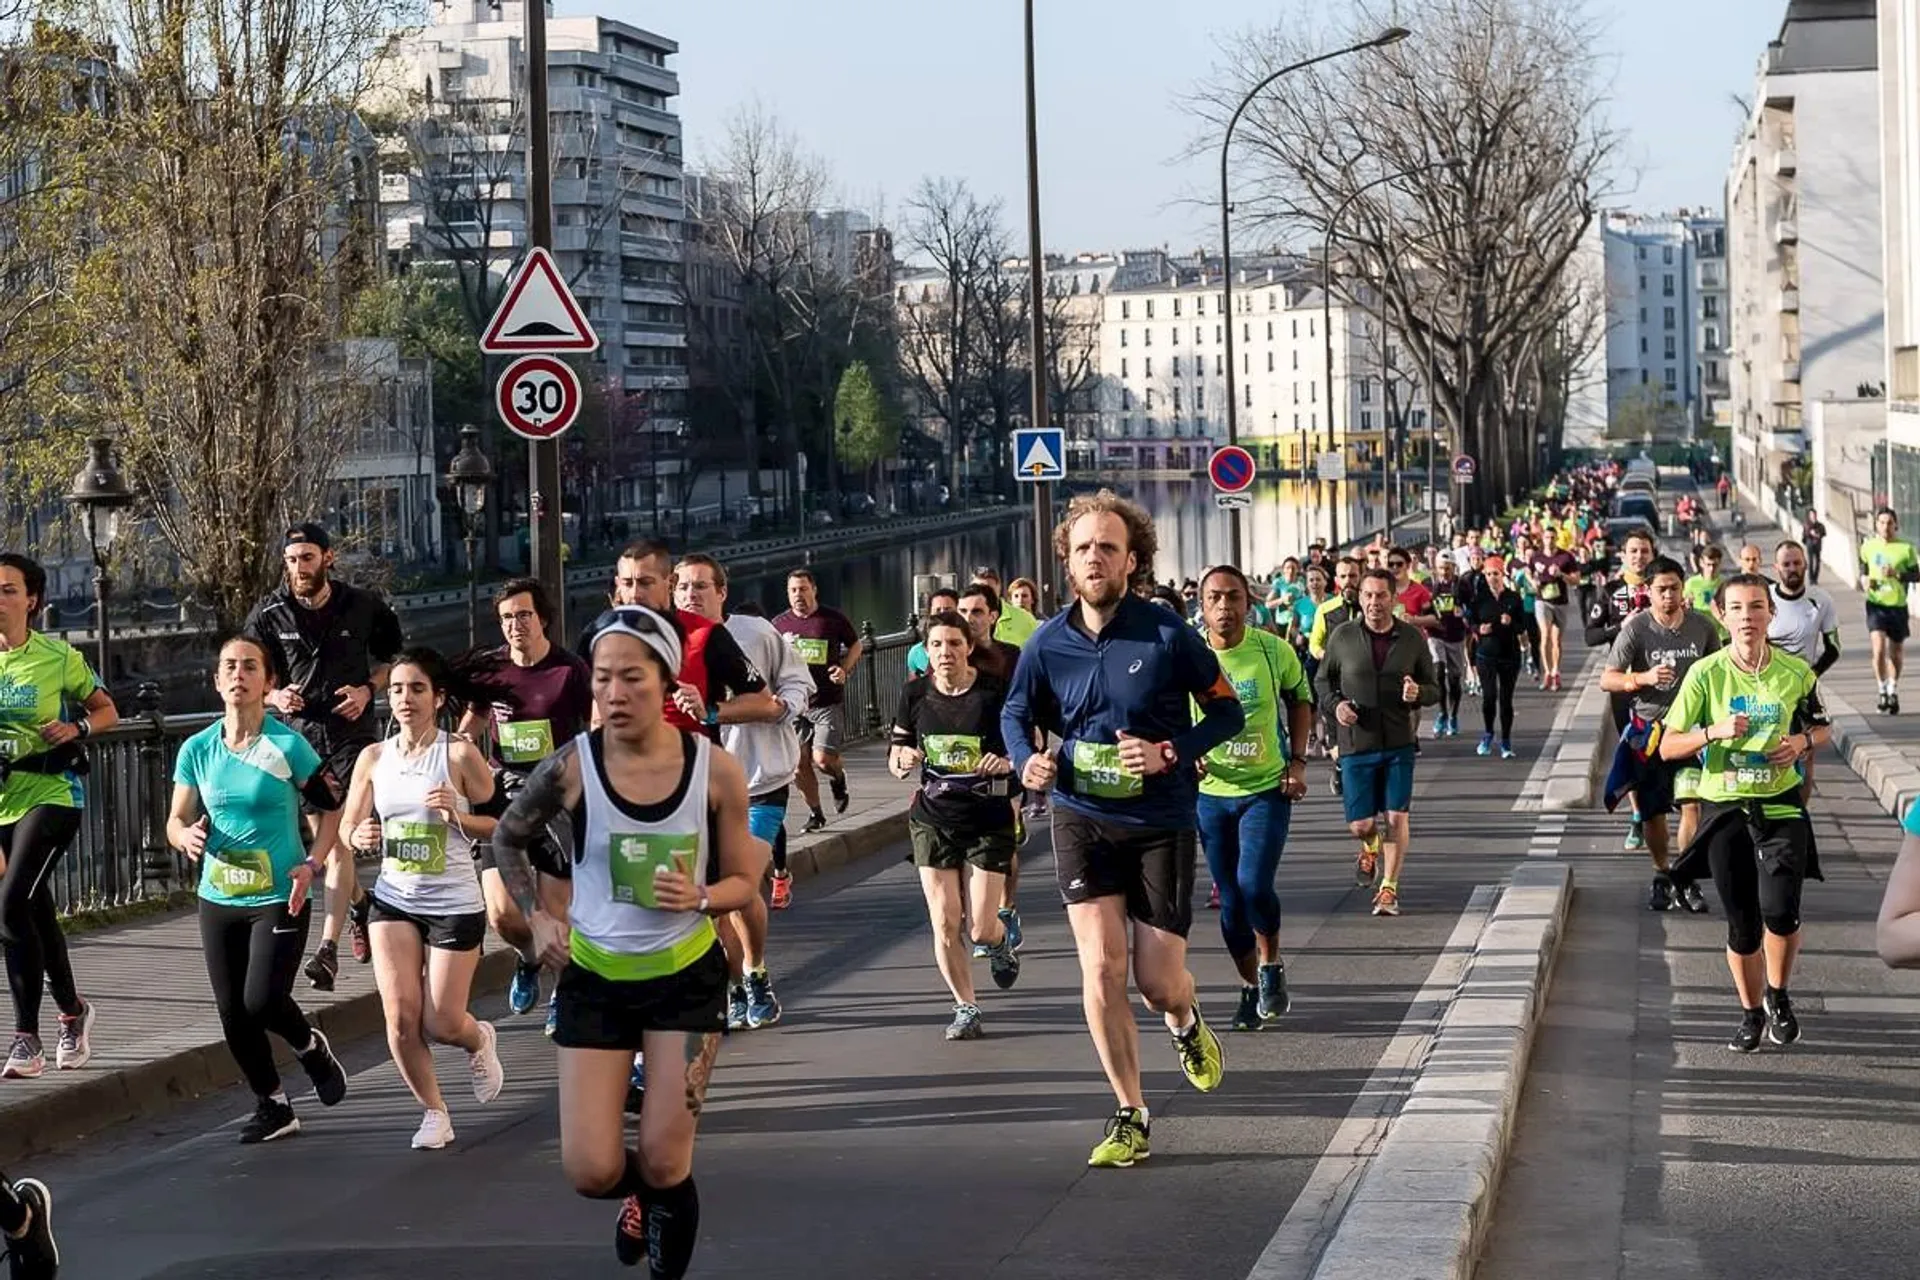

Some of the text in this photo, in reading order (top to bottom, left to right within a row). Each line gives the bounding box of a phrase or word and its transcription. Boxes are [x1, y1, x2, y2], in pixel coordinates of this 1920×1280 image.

[516, 380, 563, 415] 30
[1225, 741, 1258, 756] 7802
[1091, 765, 1120, 785] 533
[397, 842, 430, 861] 1688
[222, 869, 256, 884] 1687
